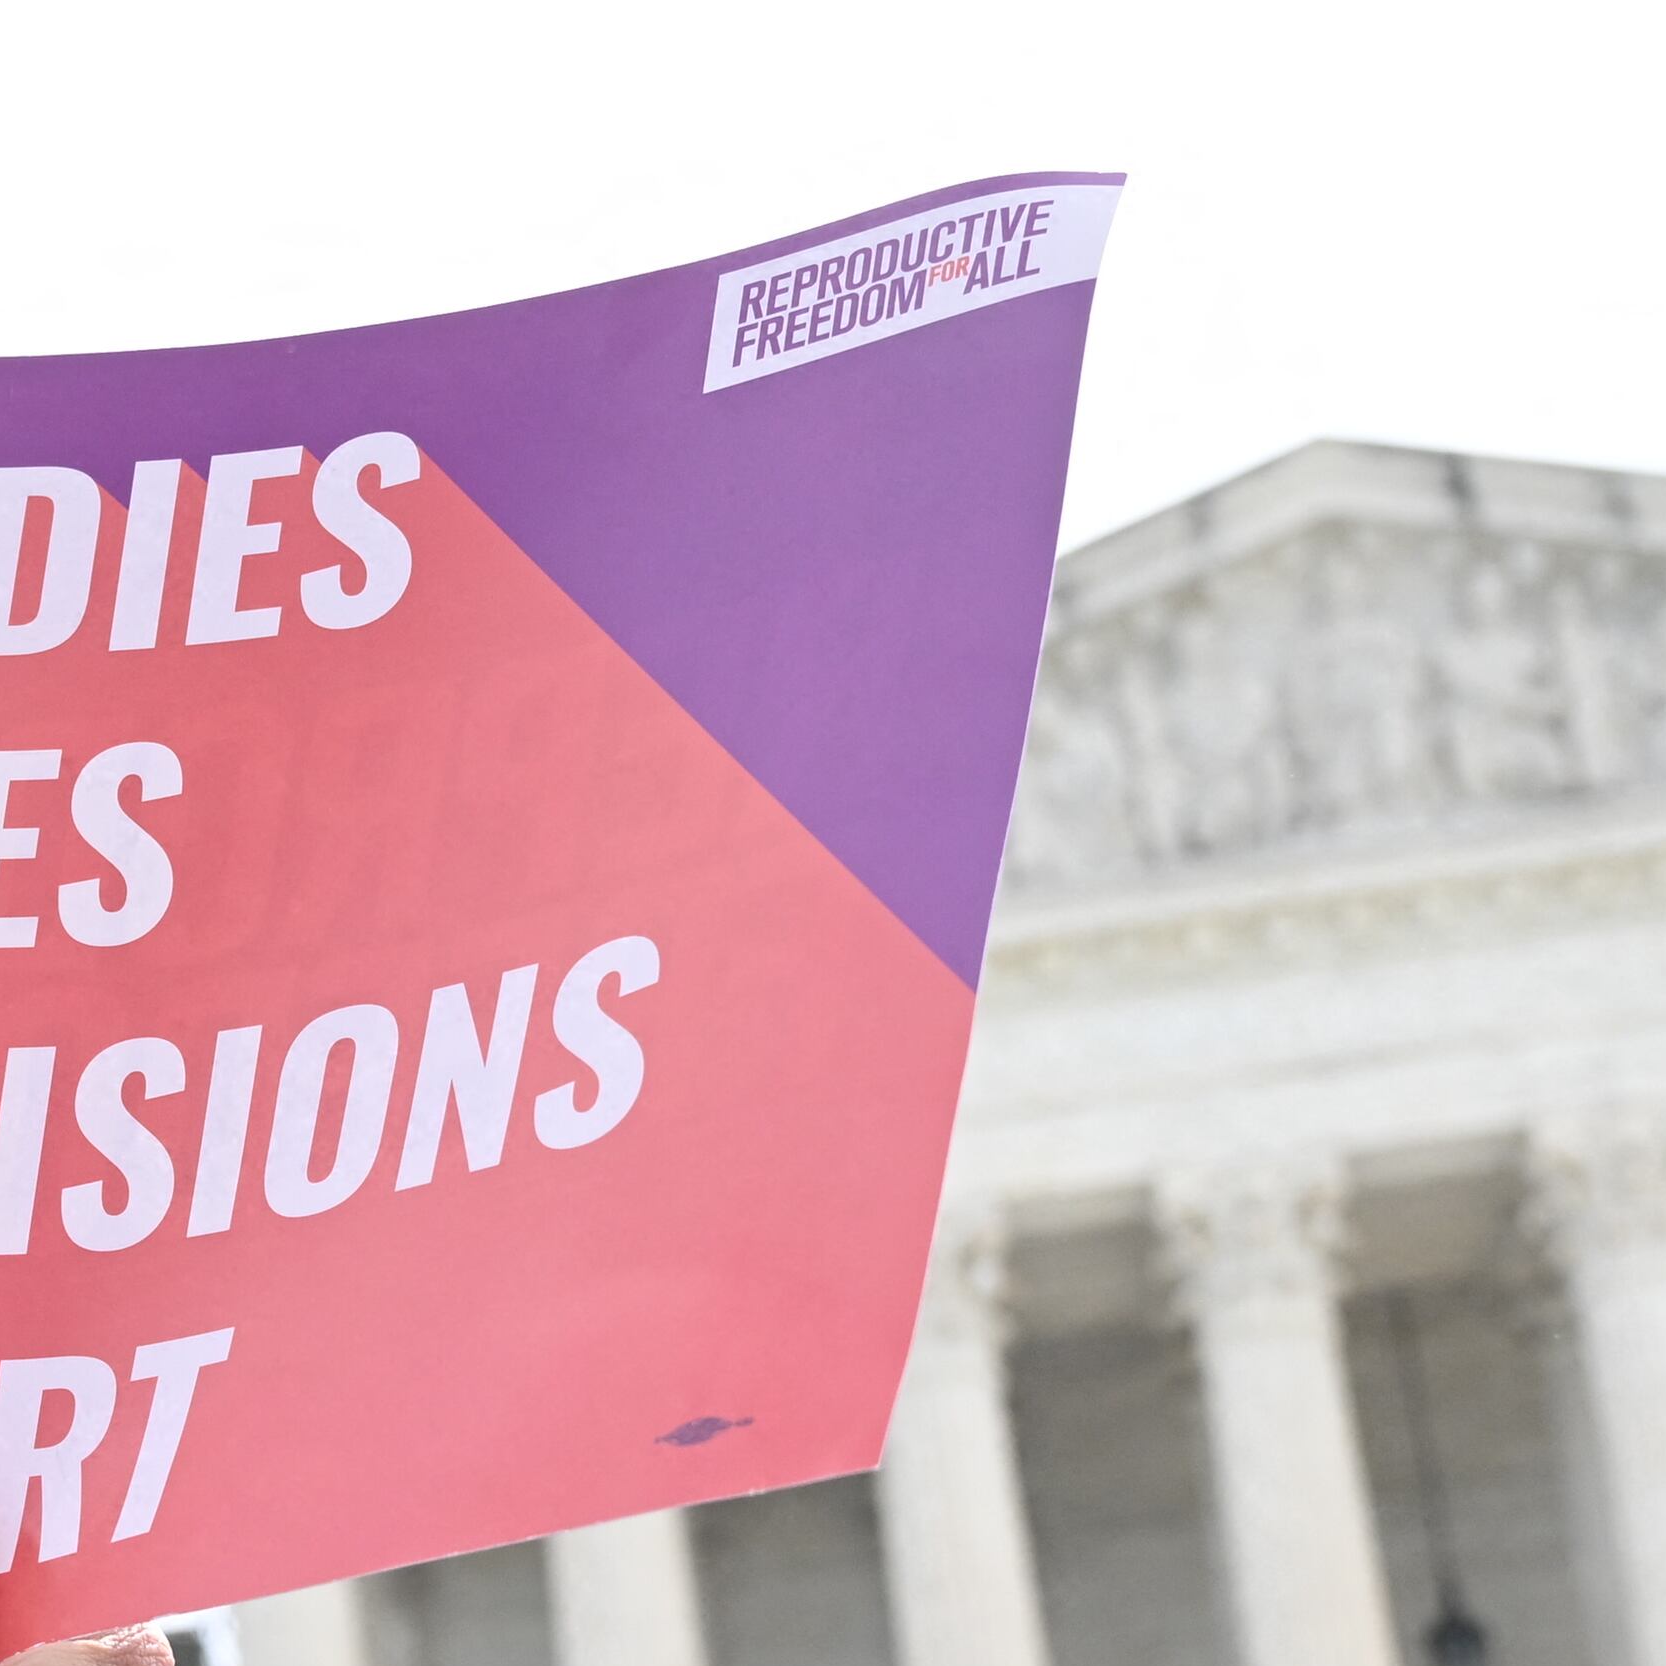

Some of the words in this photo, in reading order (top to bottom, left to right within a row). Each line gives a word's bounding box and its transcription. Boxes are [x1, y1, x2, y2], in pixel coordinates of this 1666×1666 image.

[733, 269, 930, 368] FREEDOM
[928, 256, 969, 287] FOR
[963, 240, 1040, 294] ALL
[738, 200, 1054, 323] REPRODUCTIVE
